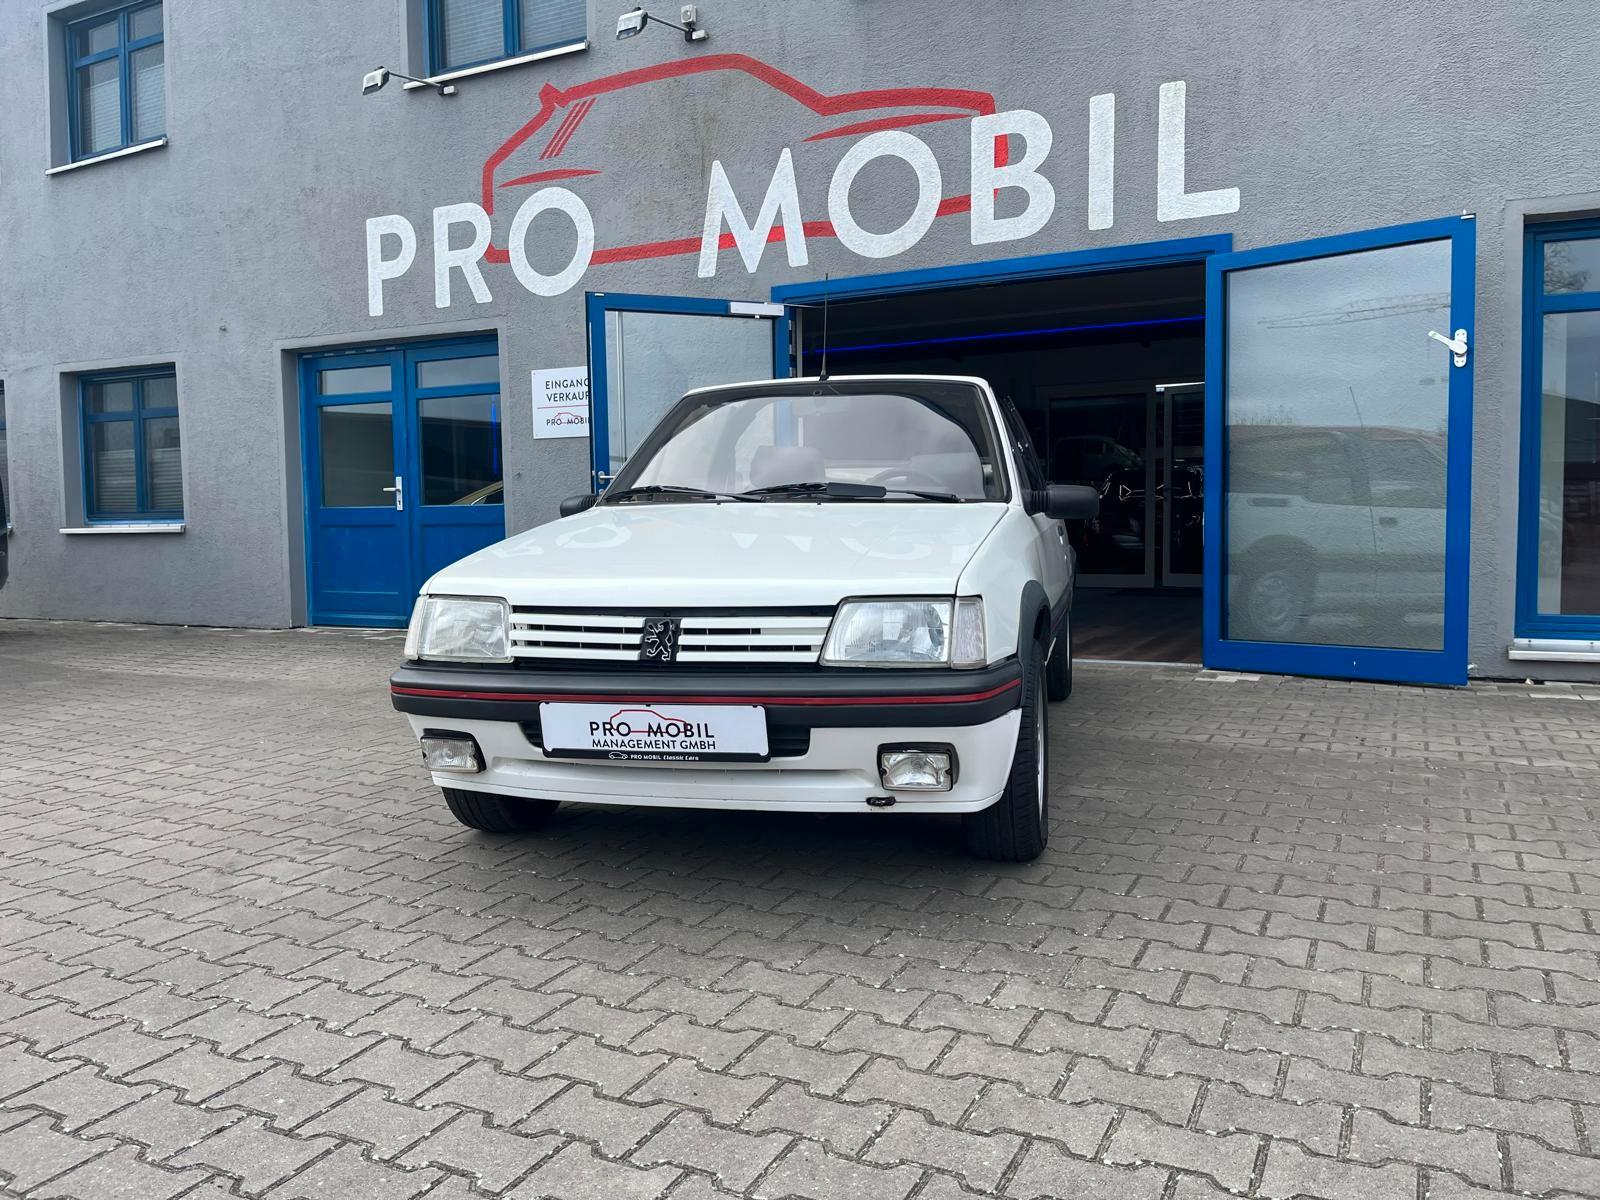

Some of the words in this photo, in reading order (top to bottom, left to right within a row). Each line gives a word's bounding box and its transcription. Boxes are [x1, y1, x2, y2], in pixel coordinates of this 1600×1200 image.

[366, 186, 595, 317] PRO
[697, 80, 1241, 278] MOBIL
[546, 417, 562, 426] PRO
[567, 416, 590, 425] MOBI
[589, 721, 631, 737] PRO
[647, 722, 714, 738] MOBIL
[592, 738, 676, 750] MANAGEMENT
[680, 740, 716, 750] GMBH
